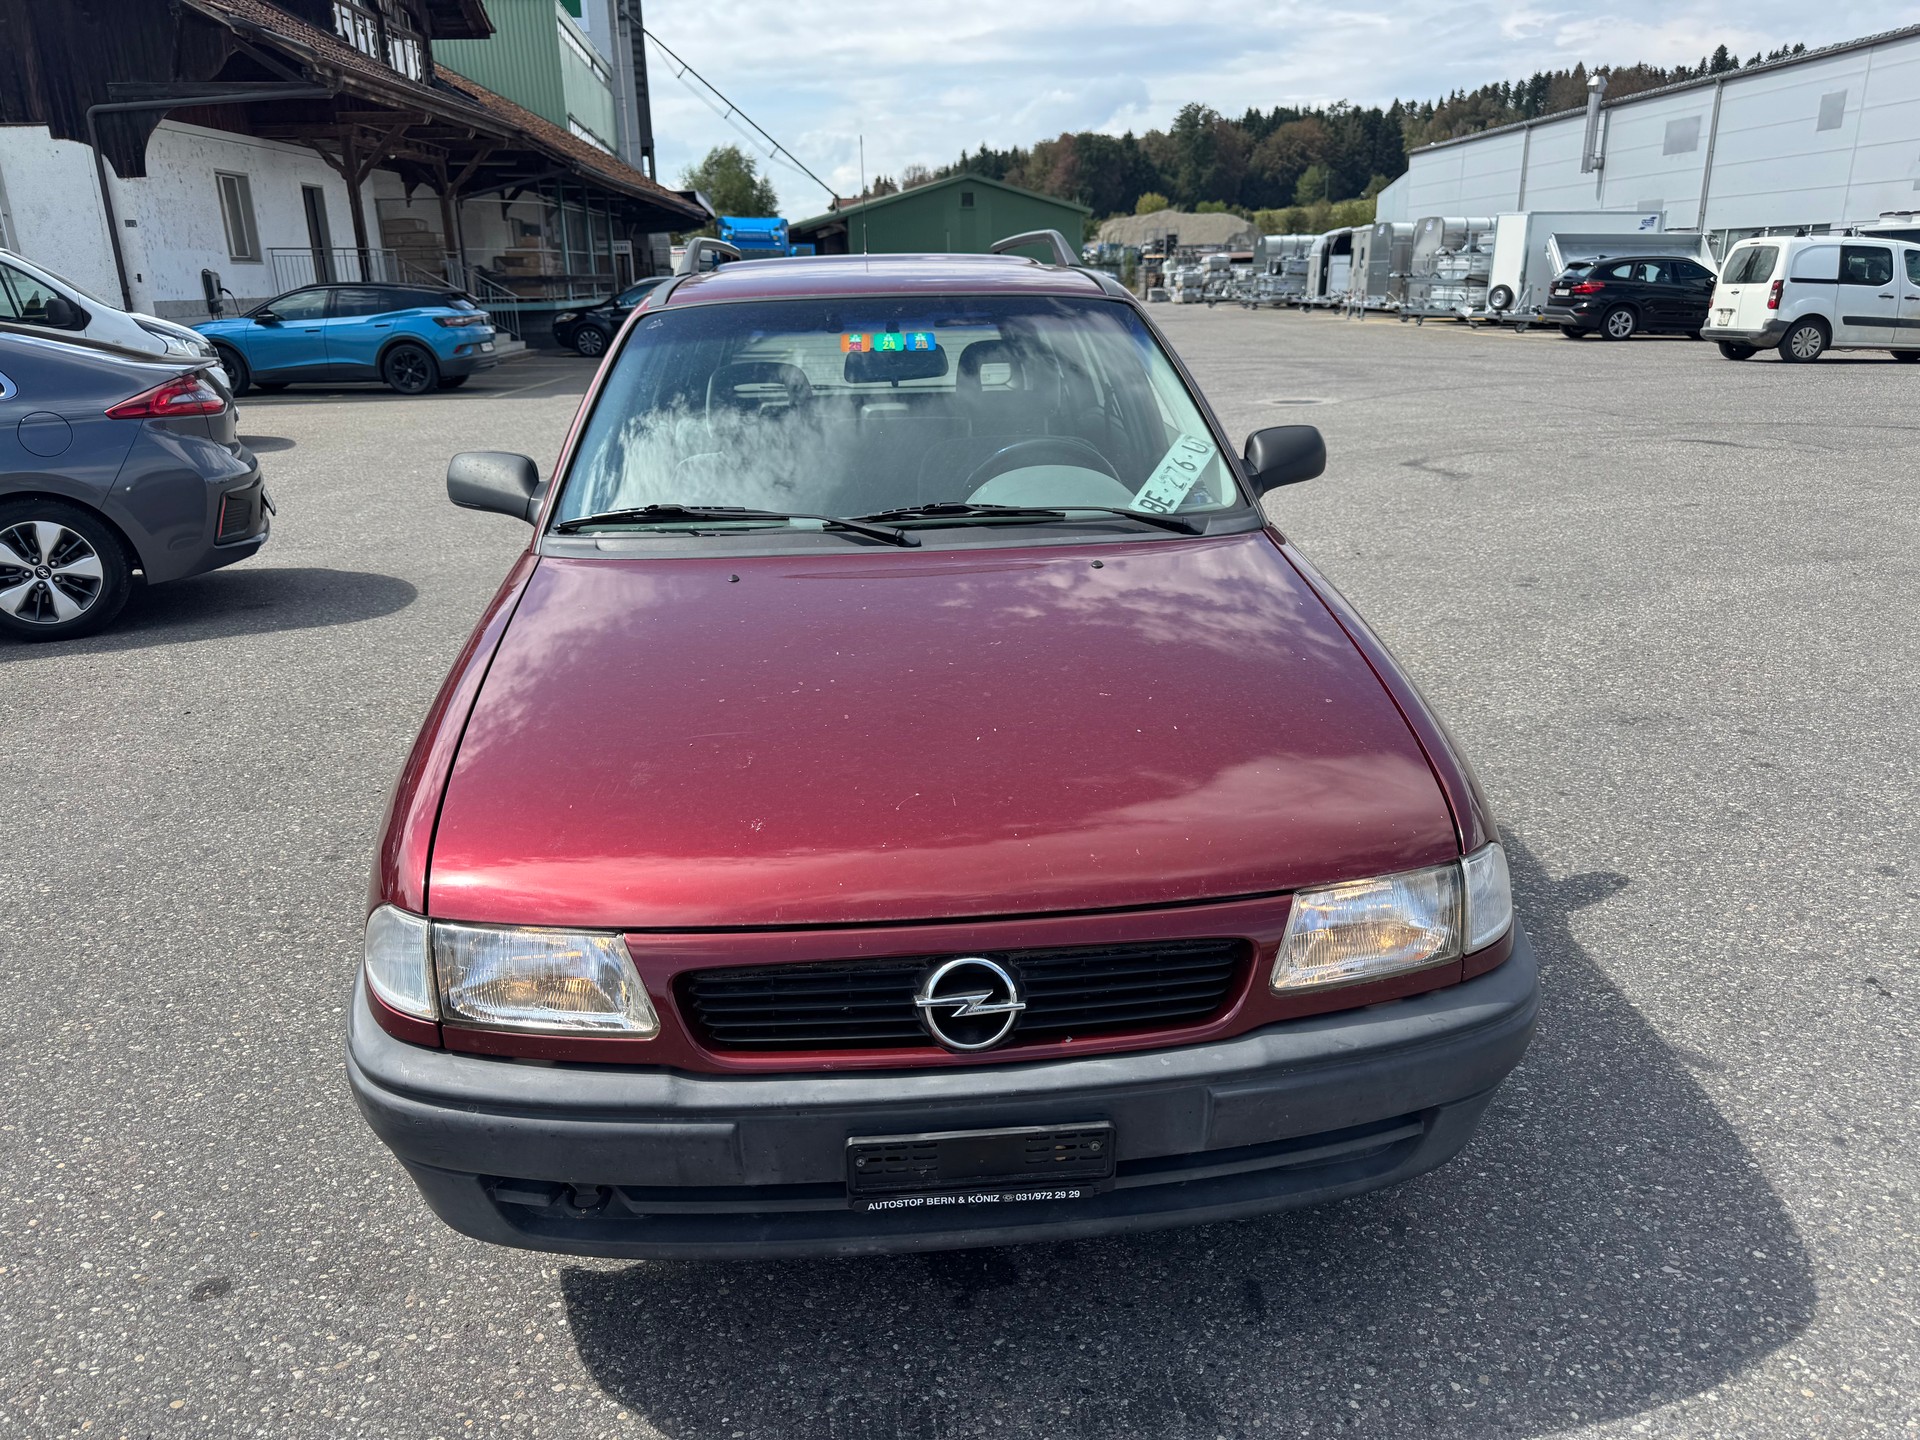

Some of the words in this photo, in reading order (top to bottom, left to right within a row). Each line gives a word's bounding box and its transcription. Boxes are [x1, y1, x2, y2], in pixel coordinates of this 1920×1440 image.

[849, 342, 862, 350] 25
[882, 341, 895, 349] 24
[868, 1198, 924, 1210] AUTOSTOP
[926, 1196, 956, 1205] BERN
[958, 1195, 965, 1204] &
[968, 1193, 1000, 1203] KÖNIZ
[1015, 1191, 1053, 1201] 031/972
[1054, 1190, 1067, 1199] 29
[1068, 1190, 1080, 1198] 29
